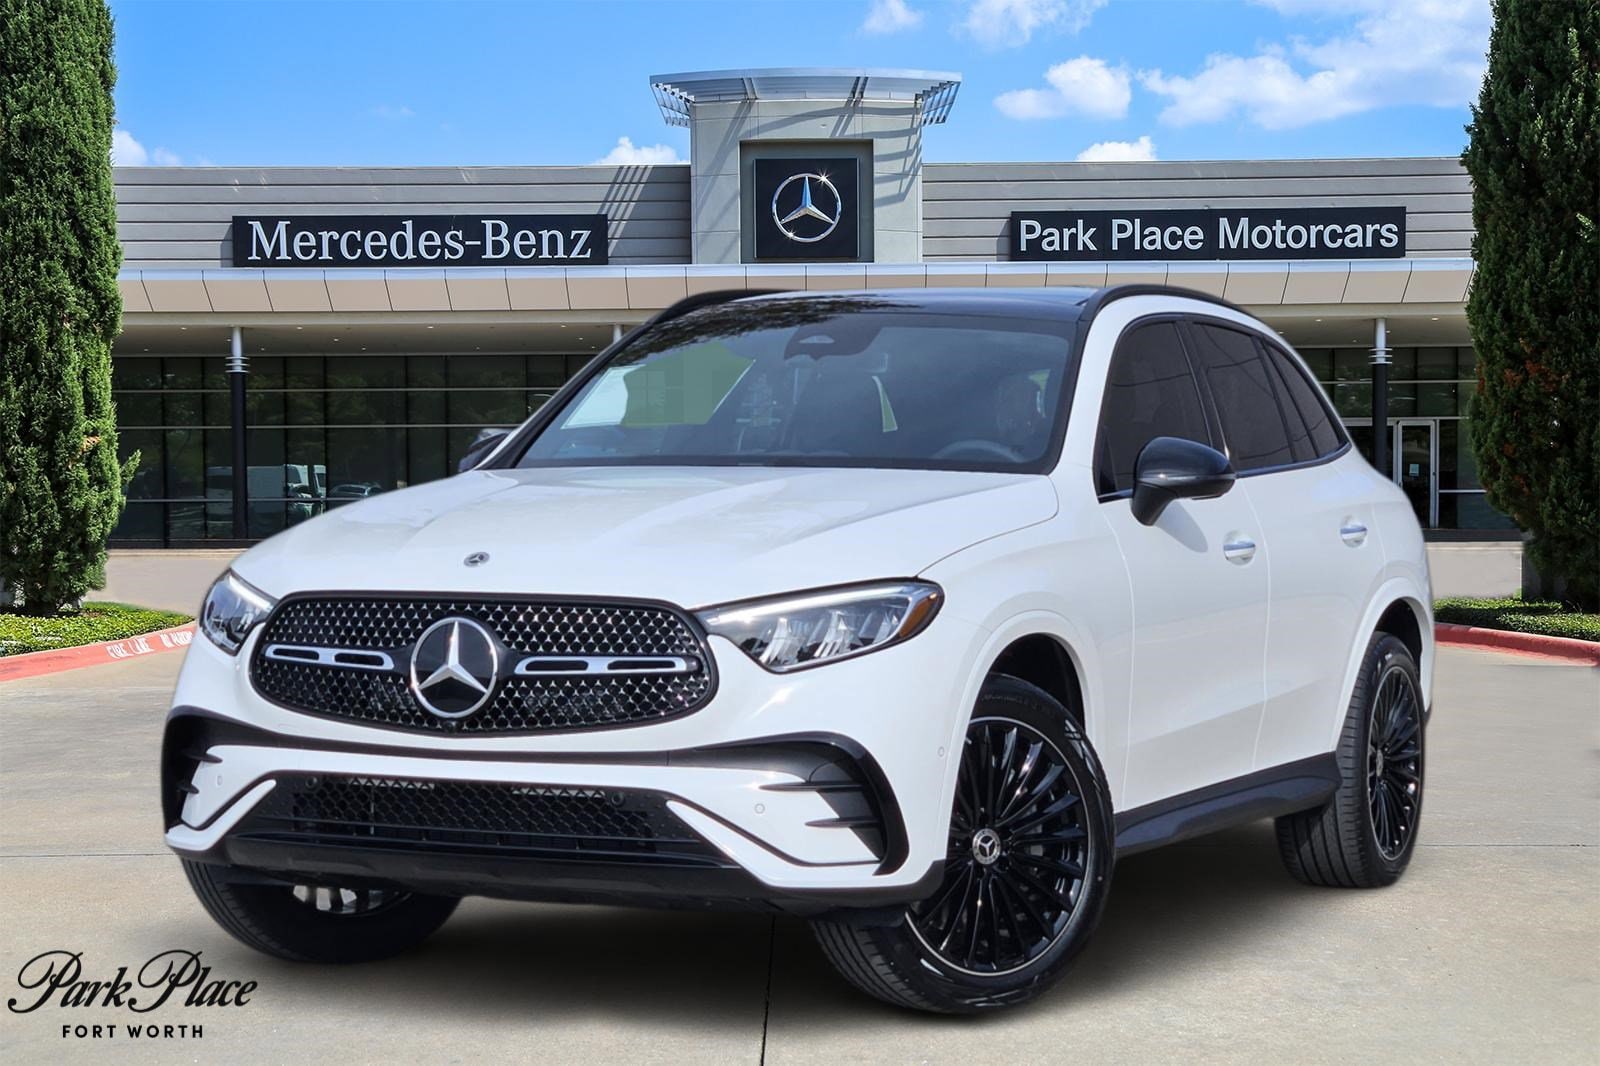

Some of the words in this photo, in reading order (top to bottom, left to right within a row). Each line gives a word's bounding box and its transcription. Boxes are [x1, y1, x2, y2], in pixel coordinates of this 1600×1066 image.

[247, 220, 592, 260] Mercedes-Benz
[1019, 219, 1097, 252] Park
[1111, 217, 1204, 251] Place
[1218, 216, 1399, 250] Motorcars
